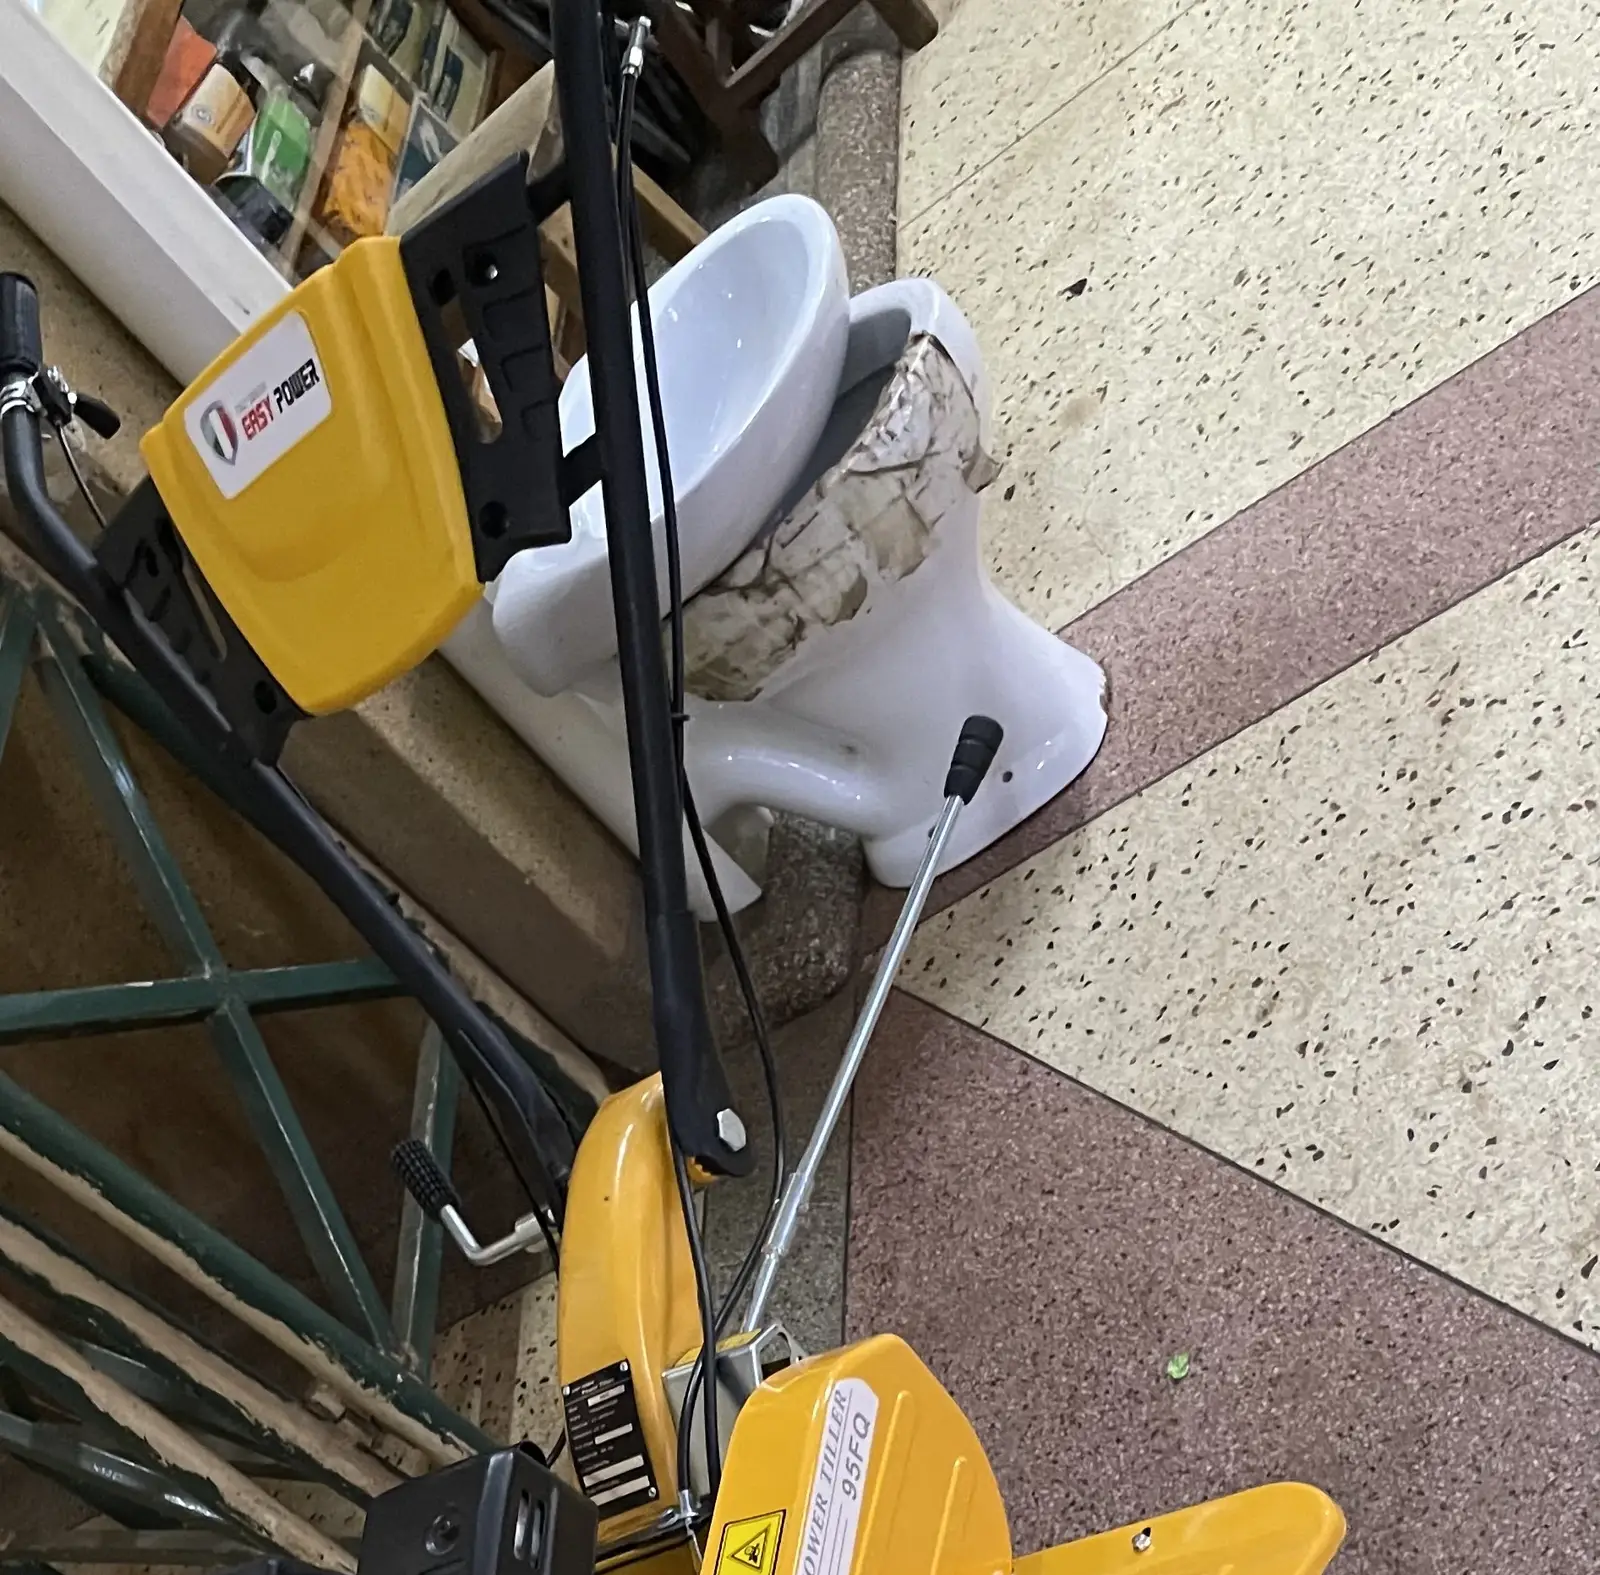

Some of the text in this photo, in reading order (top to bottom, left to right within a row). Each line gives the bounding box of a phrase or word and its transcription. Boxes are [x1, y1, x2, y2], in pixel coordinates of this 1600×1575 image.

[241, 394, 274, 441] EASY
[273, 358, 320, 414] POWER
[820, 1389, 847, 1487] TILLER
[842, 1411, 871, 1501] 95FQ
